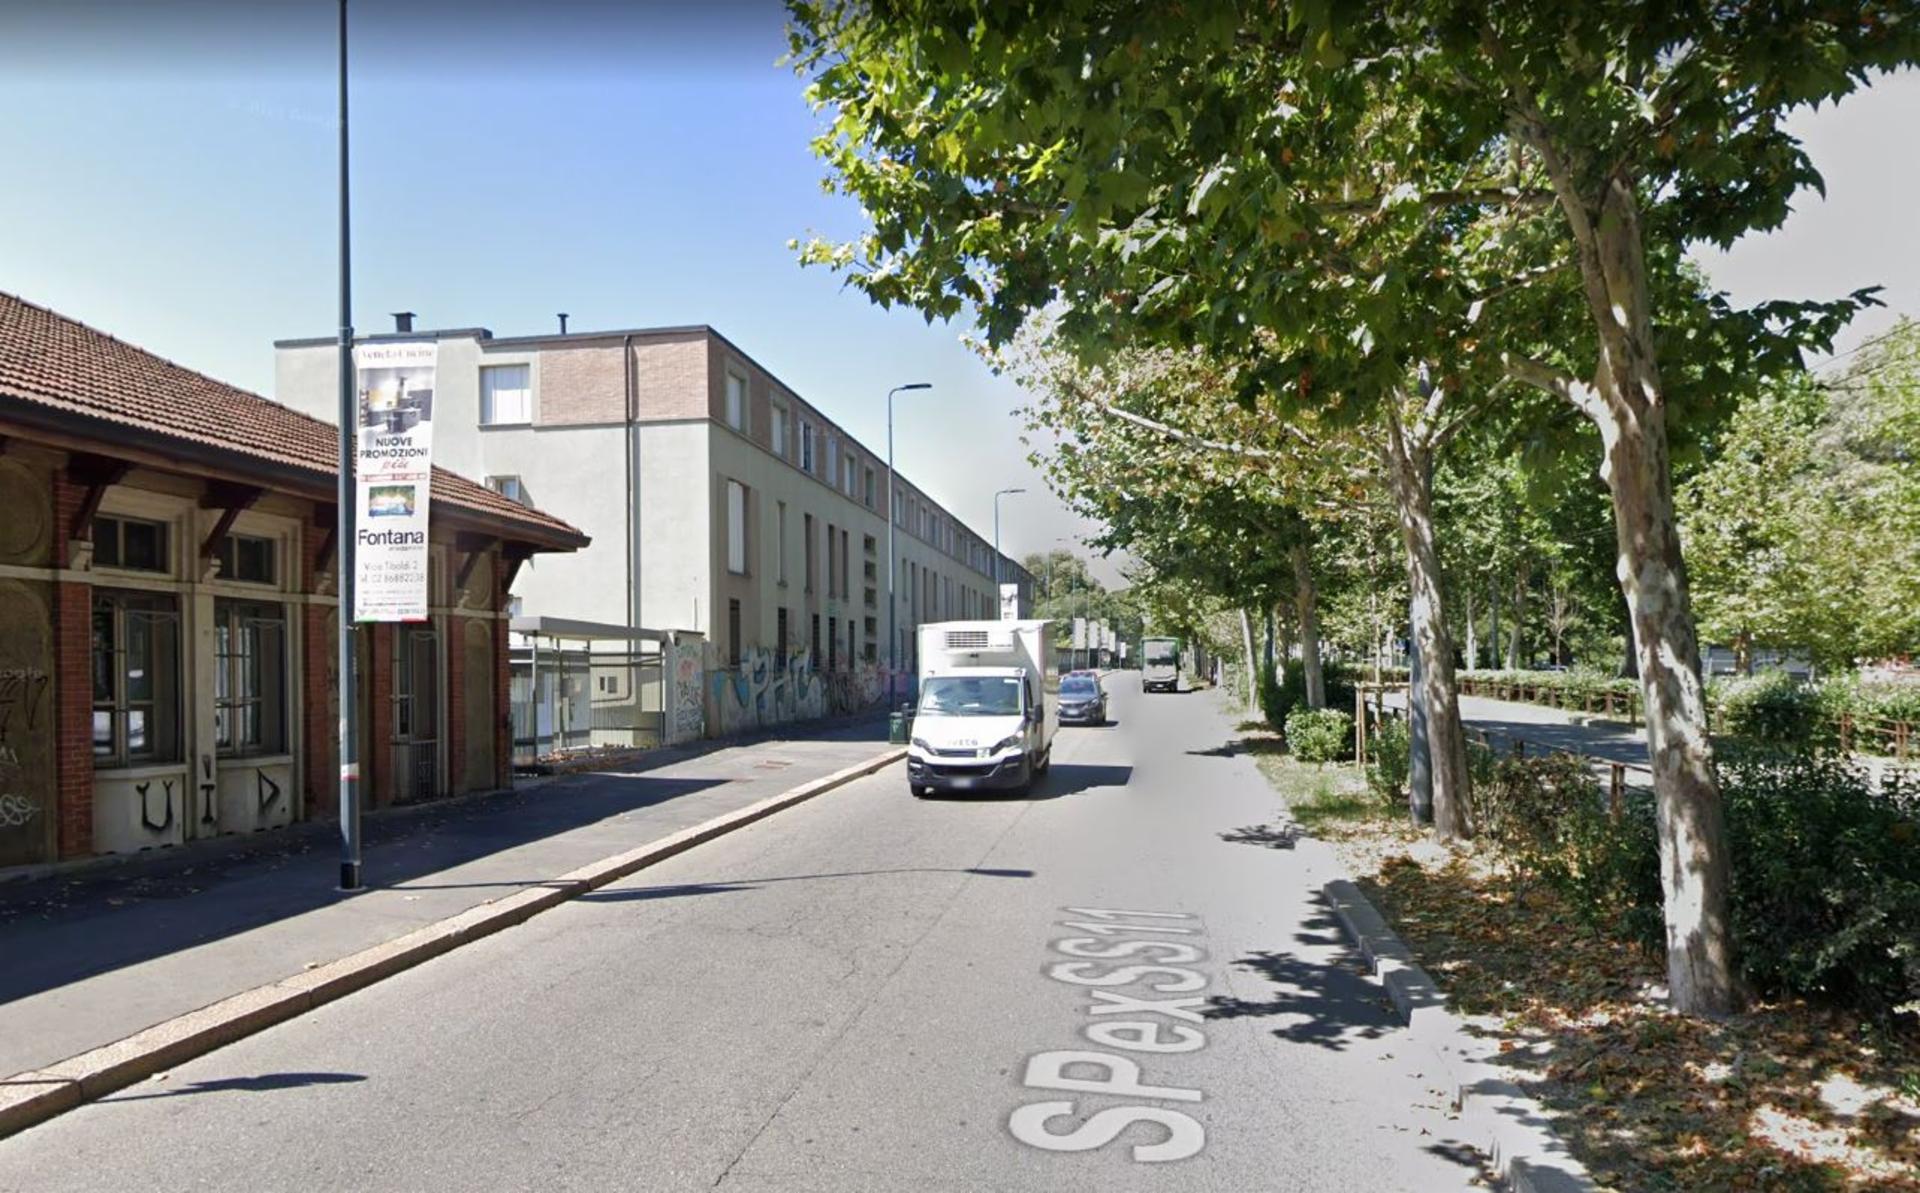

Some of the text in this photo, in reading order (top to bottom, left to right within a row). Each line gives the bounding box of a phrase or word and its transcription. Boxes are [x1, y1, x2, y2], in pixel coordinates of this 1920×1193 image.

[375, 437, 413, 447] NUOVE
[360, 448, 428, 459] PROMOZIONI
[358, 529, 425, 546] Fontana
